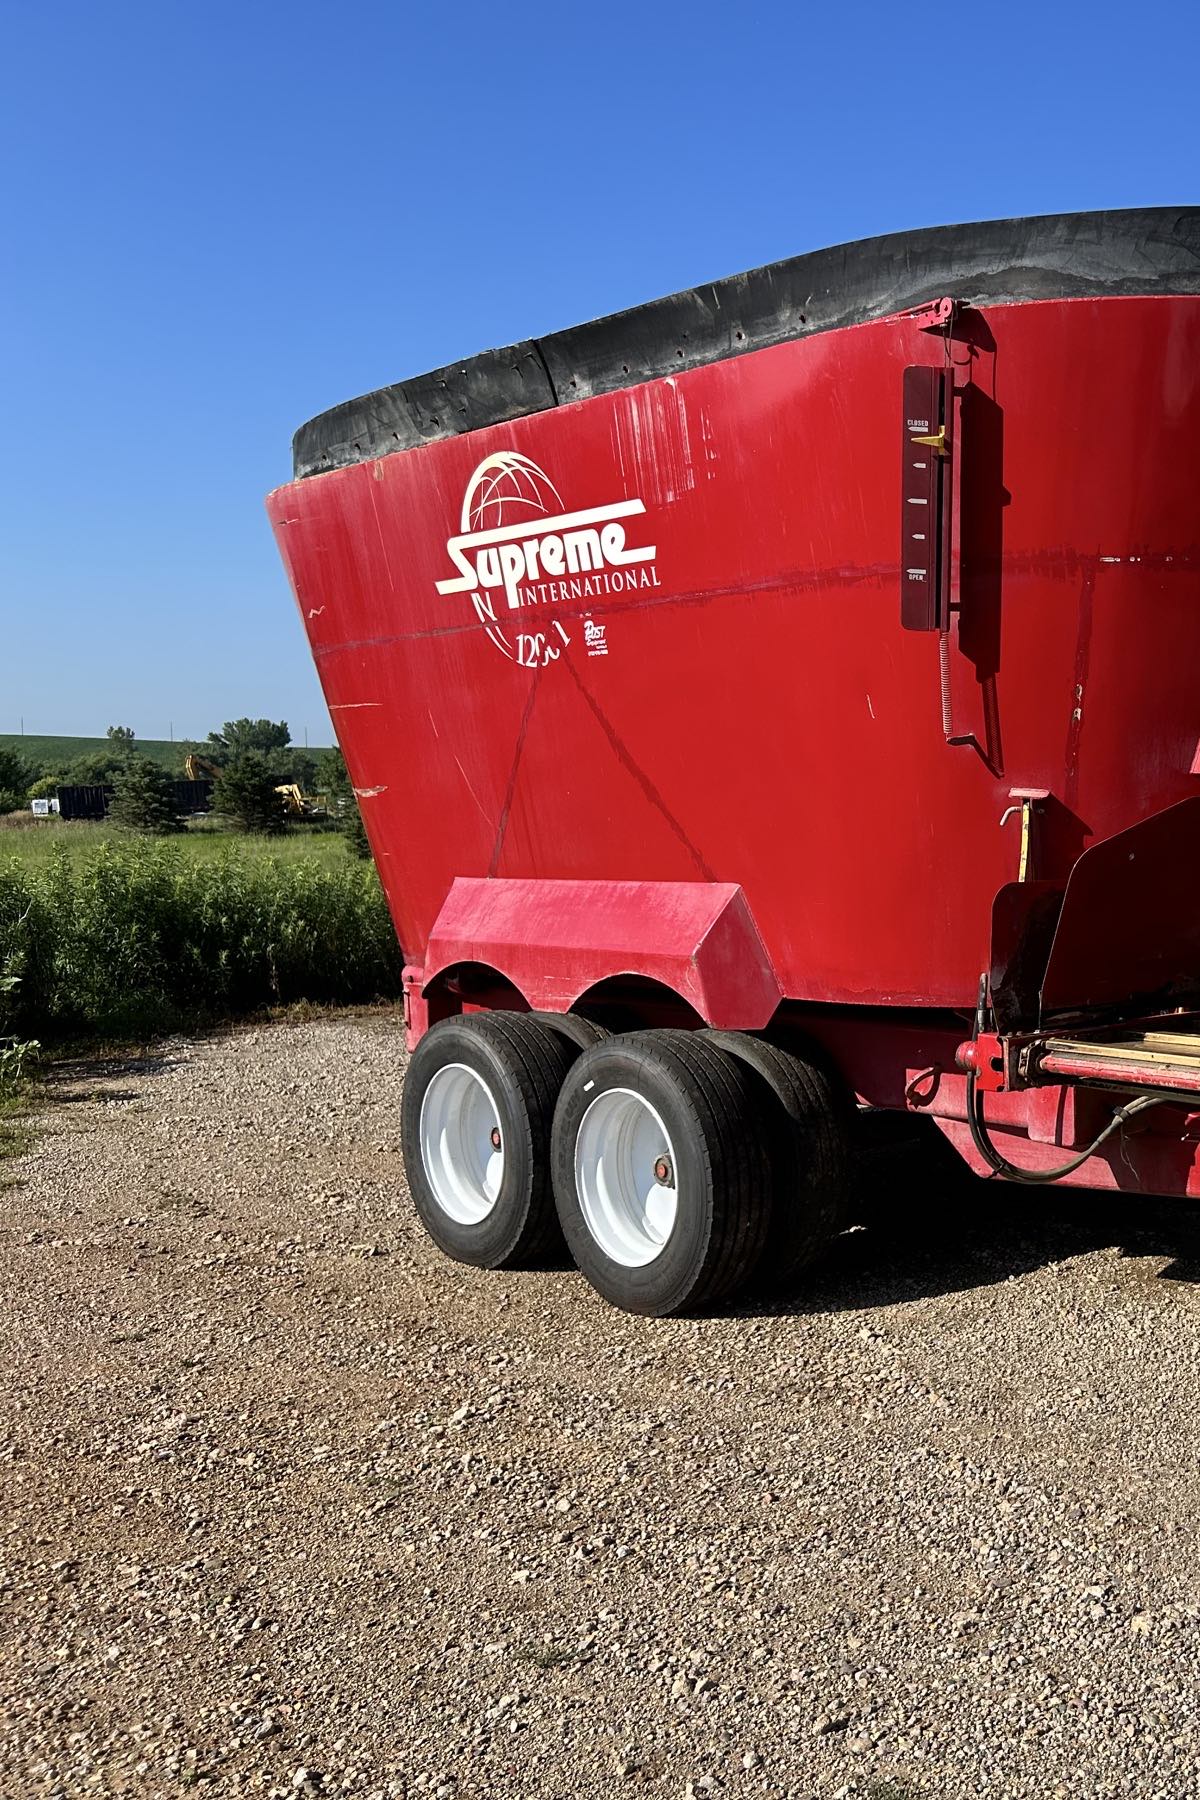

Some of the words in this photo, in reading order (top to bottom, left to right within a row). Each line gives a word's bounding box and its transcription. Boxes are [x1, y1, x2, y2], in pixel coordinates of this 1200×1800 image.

[907, 419, 929, 427] CLOSED
[435, 498, 657, 609] Supreme
[518, 566, 661, 607] INTERNATIONAL
